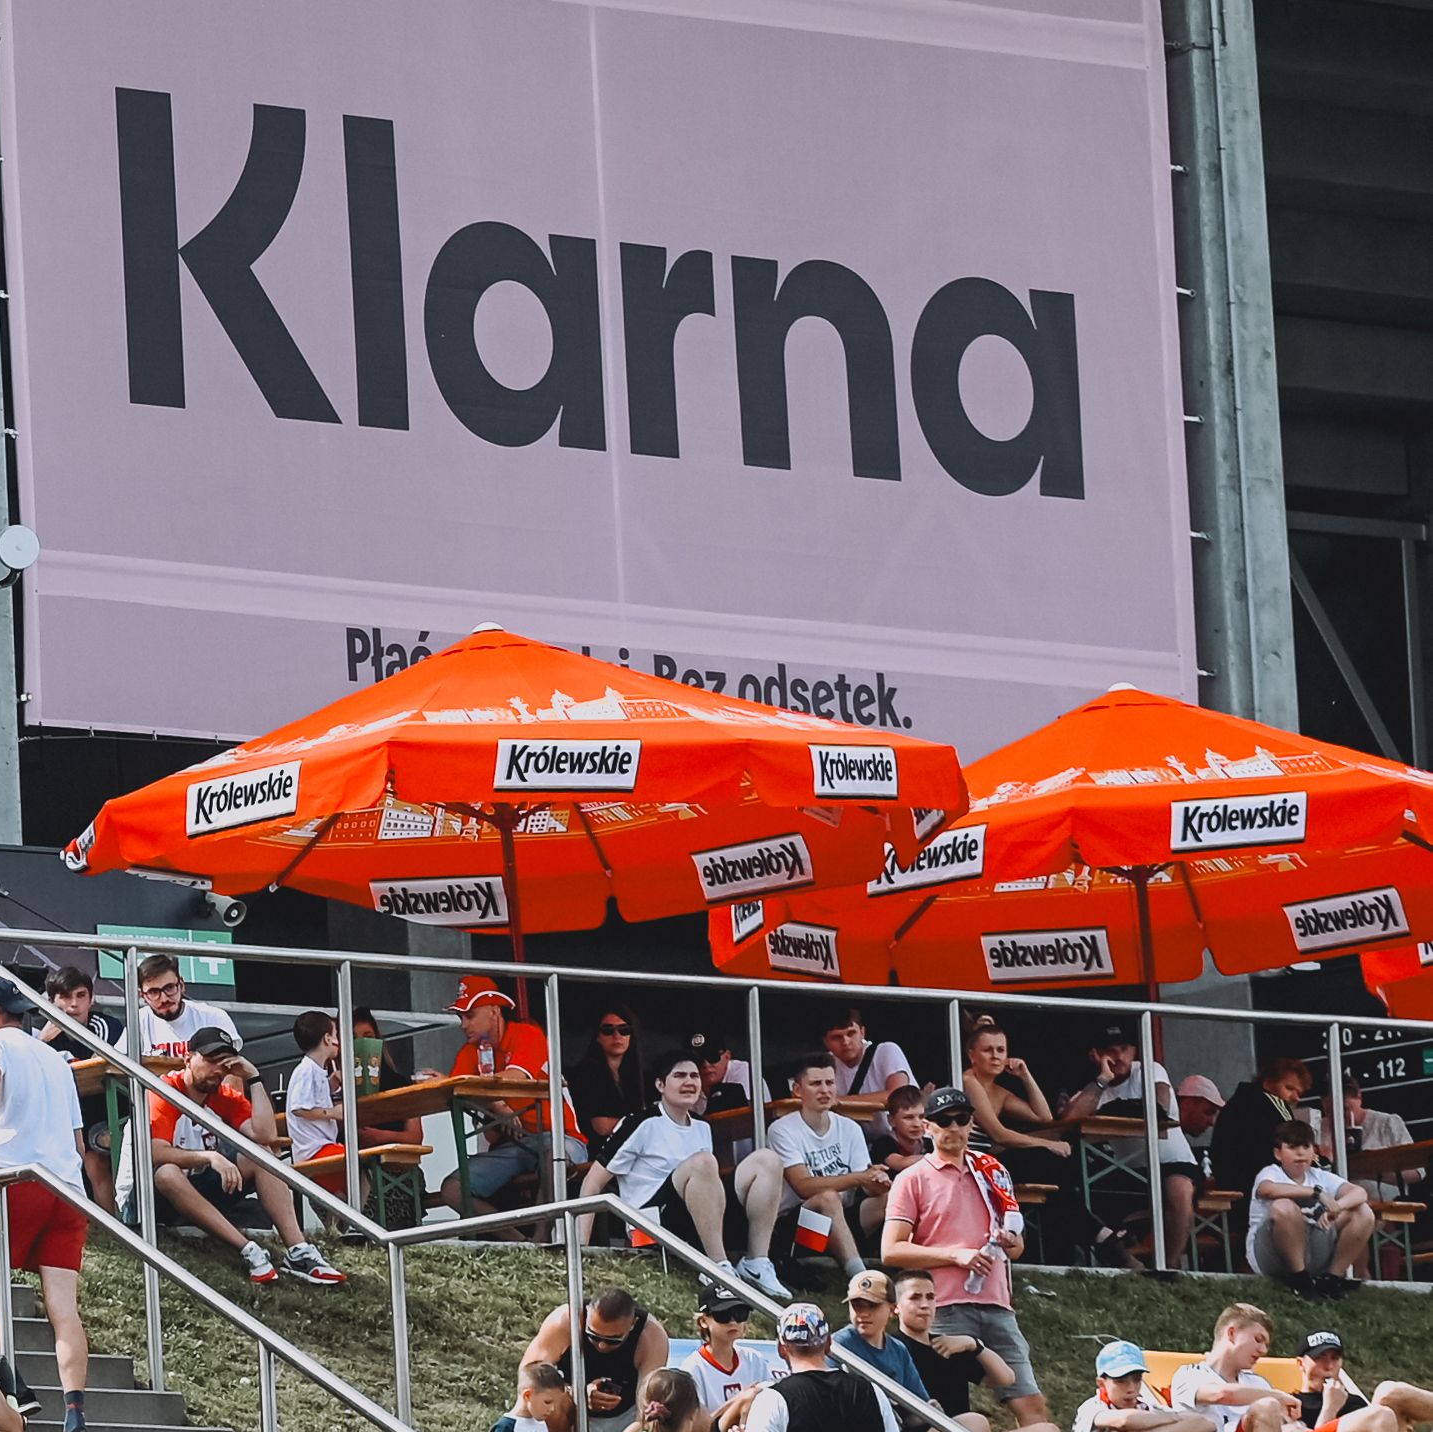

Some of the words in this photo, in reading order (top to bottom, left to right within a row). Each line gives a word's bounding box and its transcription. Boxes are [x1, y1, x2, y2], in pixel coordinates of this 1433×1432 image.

[115, 87, 1085, 500] Klarna
[506, 745, 632, 782] Królewskie
[818, 751, 892, 788] Królewskie
[195, 771, 292, 824] Królewskie
[1182, 804, 1298, 842] Królewskie
